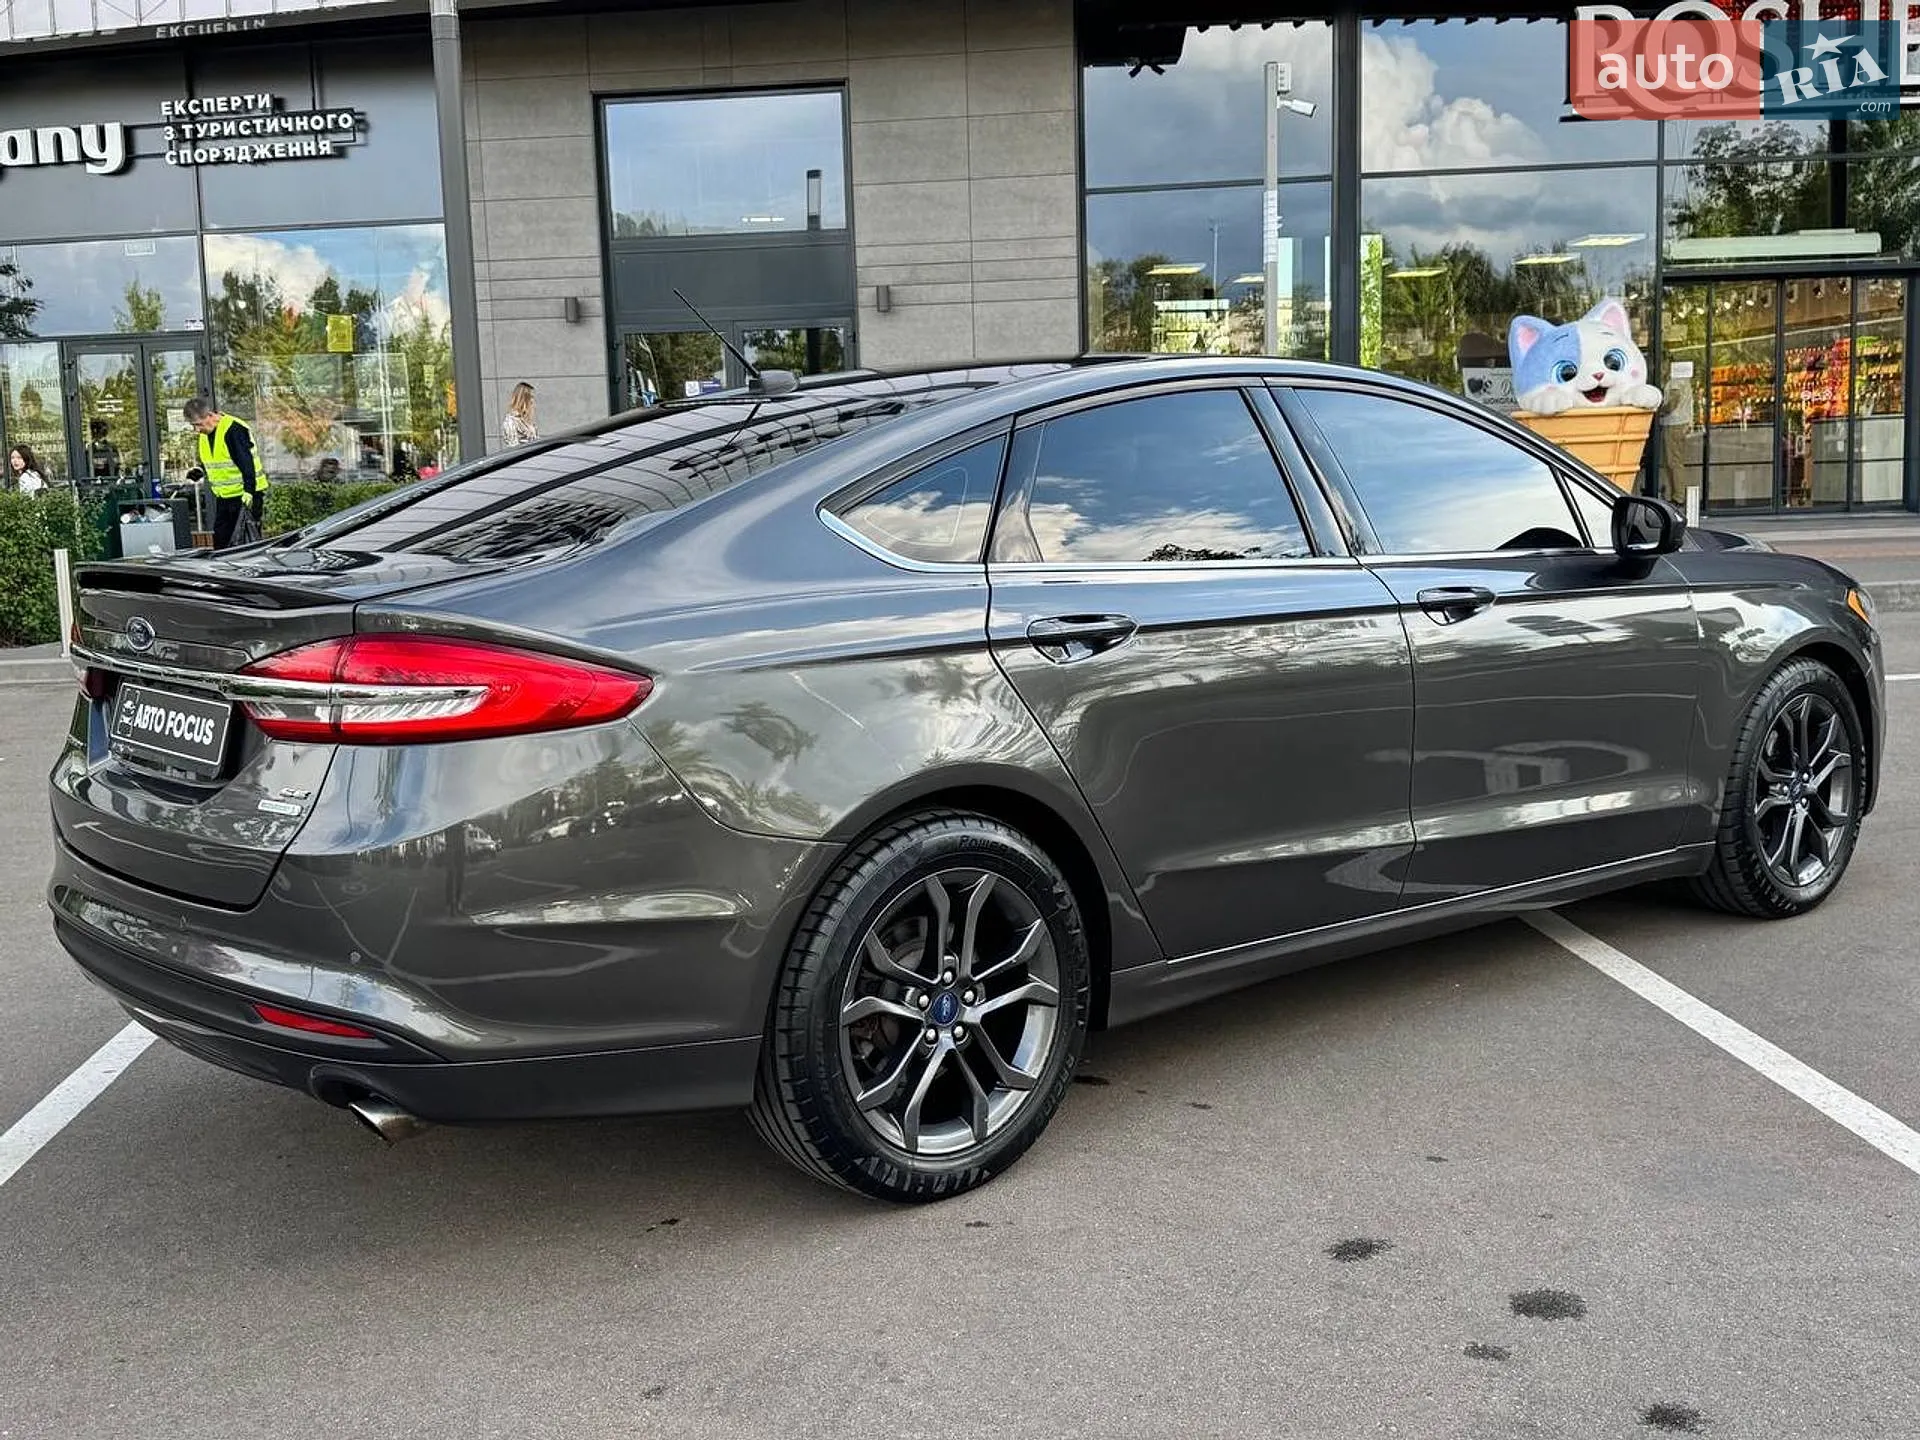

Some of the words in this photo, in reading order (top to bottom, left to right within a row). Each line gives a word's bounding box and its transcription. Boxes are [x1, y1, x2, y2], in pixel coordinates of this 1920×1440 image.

[161, 93, 271, 116] ЕКСПЕРТИ
[163, 126, 175, 141] З
[181, 113, 353, 139] ТУРИСТИЧНОГО
[0, 121, 126, 174] any
[165, 140, 333, 165] СПОРЯДЖЕННЯ
[165, 711, 215, 745] FOCUS
